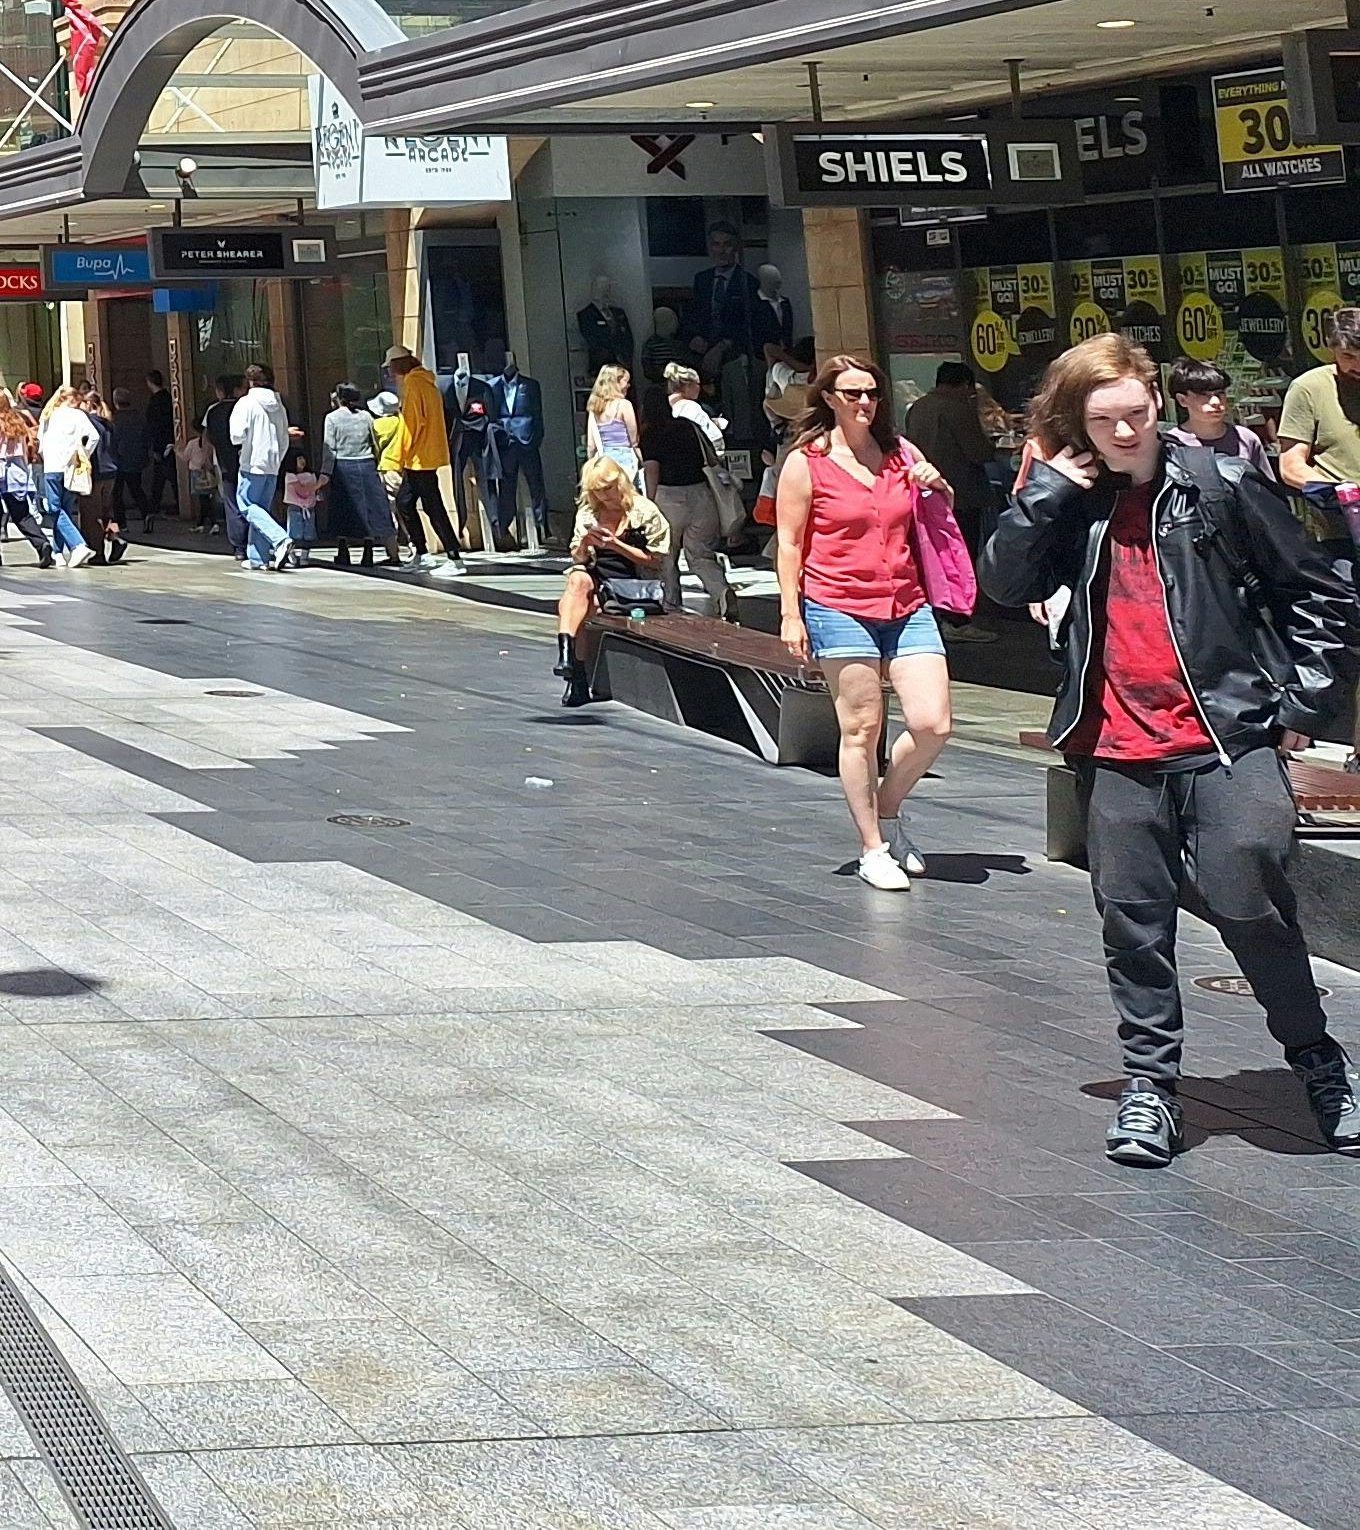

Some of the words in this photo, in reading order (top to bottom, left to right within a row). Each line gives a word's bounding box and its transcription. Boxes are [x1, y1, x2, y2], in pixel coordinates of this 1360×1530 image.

[1218, 81, 1280, 100] EVERYTHING
[408, 147, 469, 163] ARCADE
[818, 151, 967, 184] SHIELS
[1241, 163, 1264, 179] ALL
[1264, 157, 1321, 176] WATCHES
[181, 250, 214, 259] PETER
[216, 250, 264, 259] SHEARER
[76, 256, 112, 271] Bupa
[1093, 273, 1123, 287] MUST
[1209, 267, 1242, 280] MUST
[990, 278, 1017, 293] MUST
[1216, 280, 1238, 294] GO!
[996, 292, 1015, 304] GO!
[1100, 287, 1119, 300] GO!
